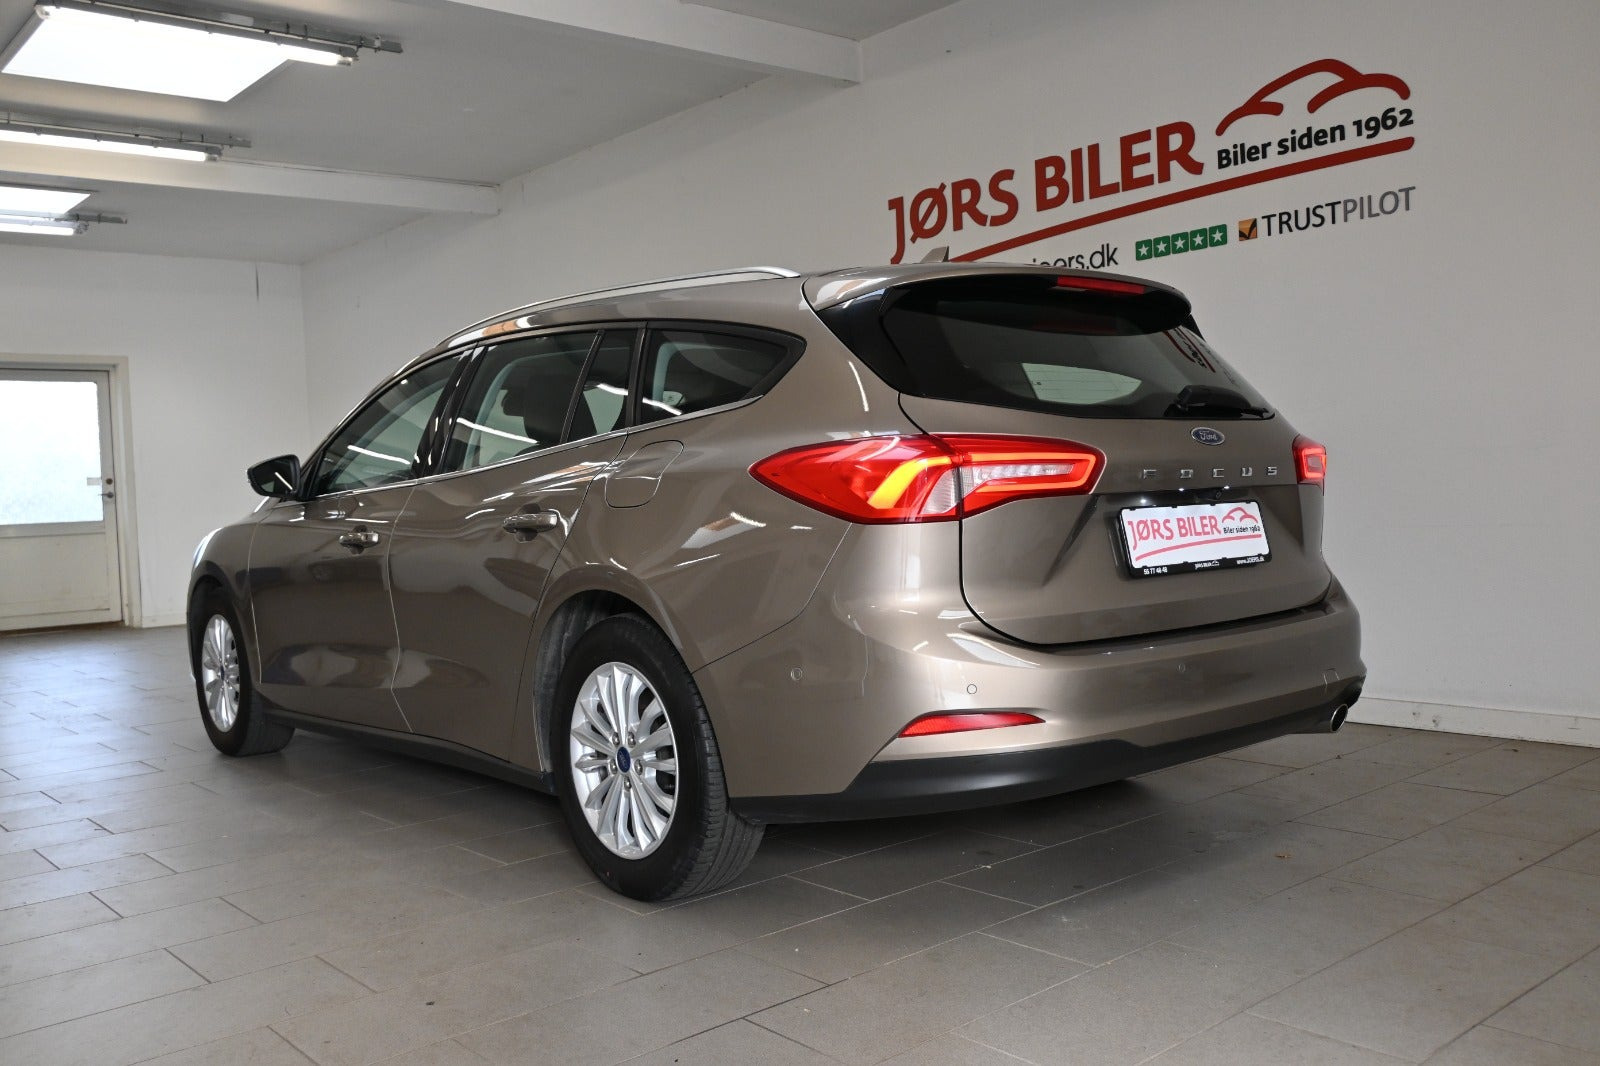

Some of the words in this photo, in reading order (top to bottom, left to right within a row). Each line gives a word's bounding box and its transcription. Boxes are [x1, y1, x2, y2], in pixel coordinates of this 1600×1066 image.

[1217, 141, 1272, 169] Biler
[1277, 129, 1346, 156] siden
[1352, 107, 1414, 139] 1962
[888, 182, 1019, 264] JØRS
[1034, 121, 1204, 212] BILER
[1262, 186, 1416, 236] TRUSTPILOT
[1143, 466, 1277, 479] FOCUS
[1128, 519, 1174, 551] JØRS
[1176, 515, 1221, 537] BILER
